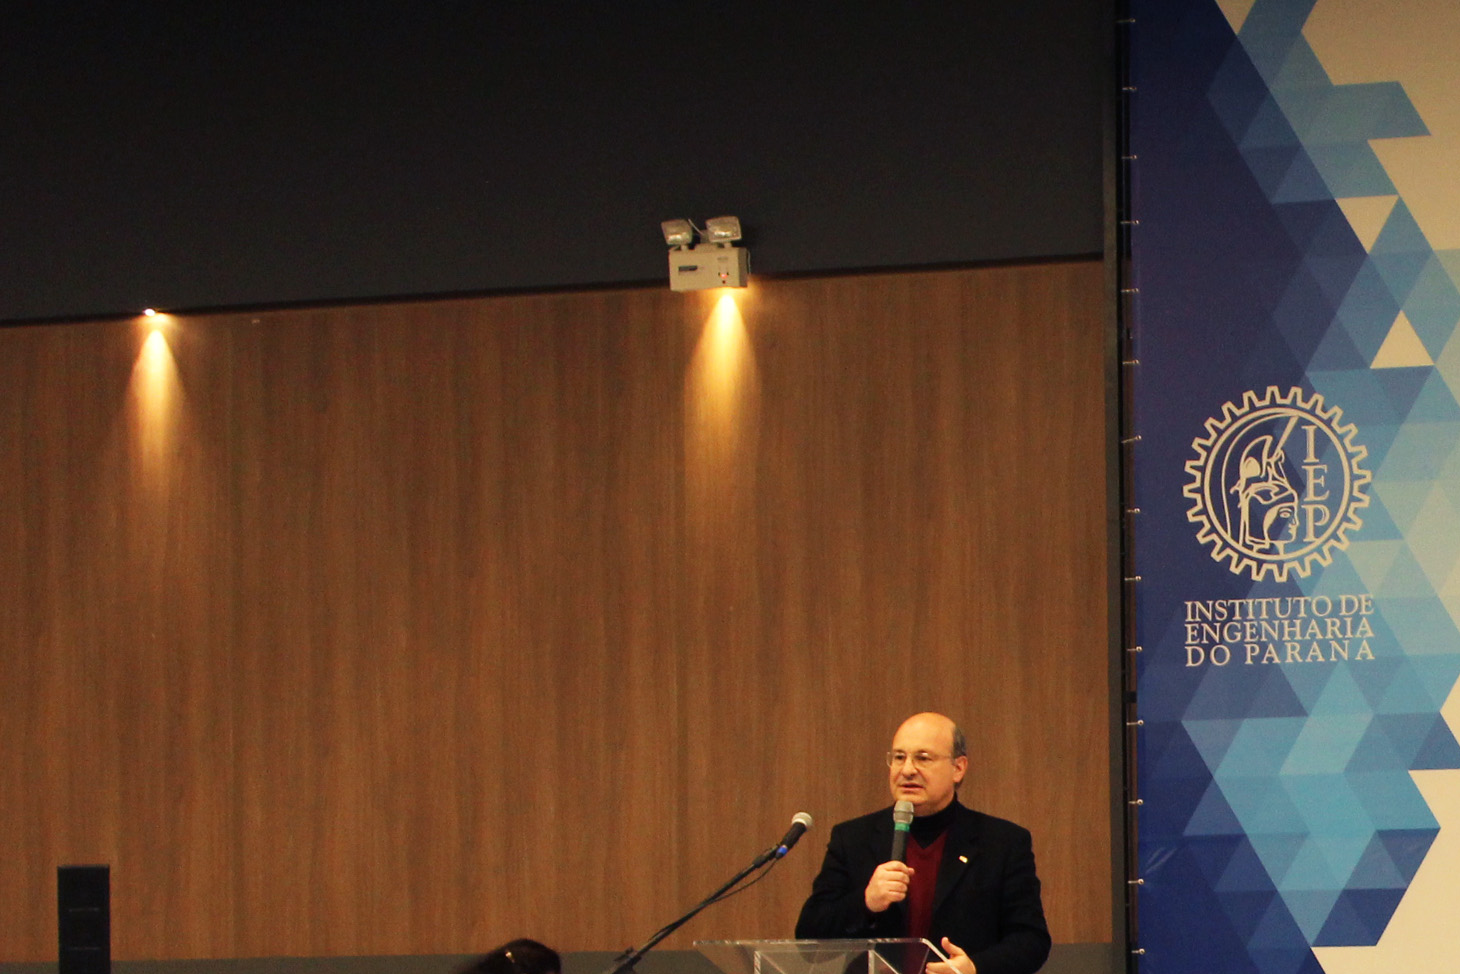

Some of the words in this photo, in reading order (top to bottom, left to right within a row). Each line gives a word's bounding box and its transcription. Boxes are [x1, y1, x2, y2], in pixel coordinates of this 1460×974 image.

[1301, 425, 1330, 543] IEP
[1184, 596, 1333, 622] INSTITUTO
[1339, 594, 1375, 616] DE
[1184, 617, 1375, 645] ENGENHARIA
[1185, 645, 1231, 668] DO
